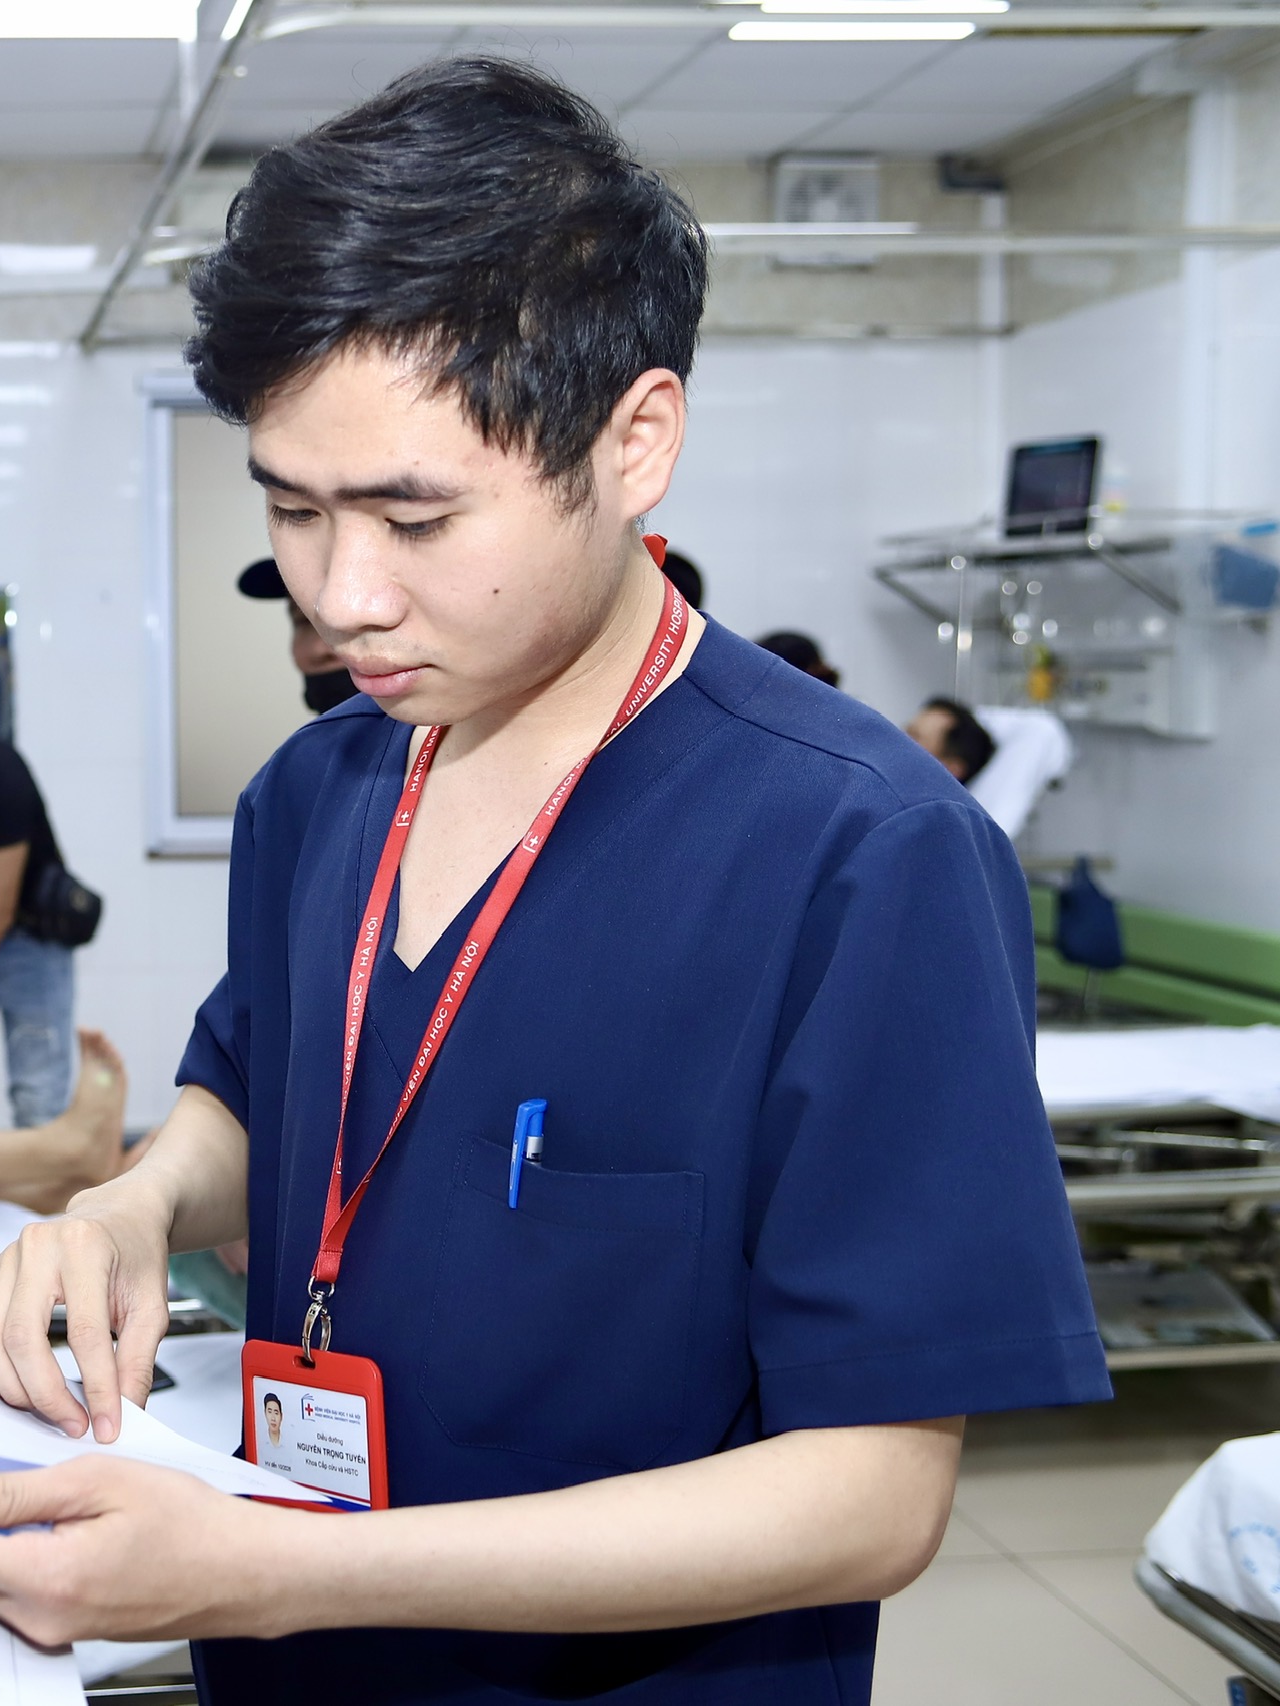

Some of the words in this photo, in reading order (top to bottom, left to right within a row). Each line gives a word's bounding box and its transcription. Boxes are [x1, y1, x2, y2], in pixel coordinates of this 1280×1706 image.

[625, 633, 675, 717] UNIVERSITY
[668, 584, 684, 635] HOSPITA
[410, 750, 429, 792] HANOI
[545, 773, 575, 816] HANOI
[365, 916, 379, 942] NỘI
[359, 946, 372, 966] HÀ
[356, 971, 365, 980] Y
[352, 984, 363, 1017] HỌC
[403, 1069, 421, 1102] VIỆN
[418, 1041, 433, 1067] ĐẠI
[429, 1007, 448, 1040] HỌC
[444, 993, 453, 1004] Y
[450, 971, 466, 992] HÀ
[461, 940, 480, 968] NỘI
[305, 1458, 317, 1467] Khoa
[344, 1467, 359, 1477] HSTC
[323, 1447, 344, 1460] TRỌNG
